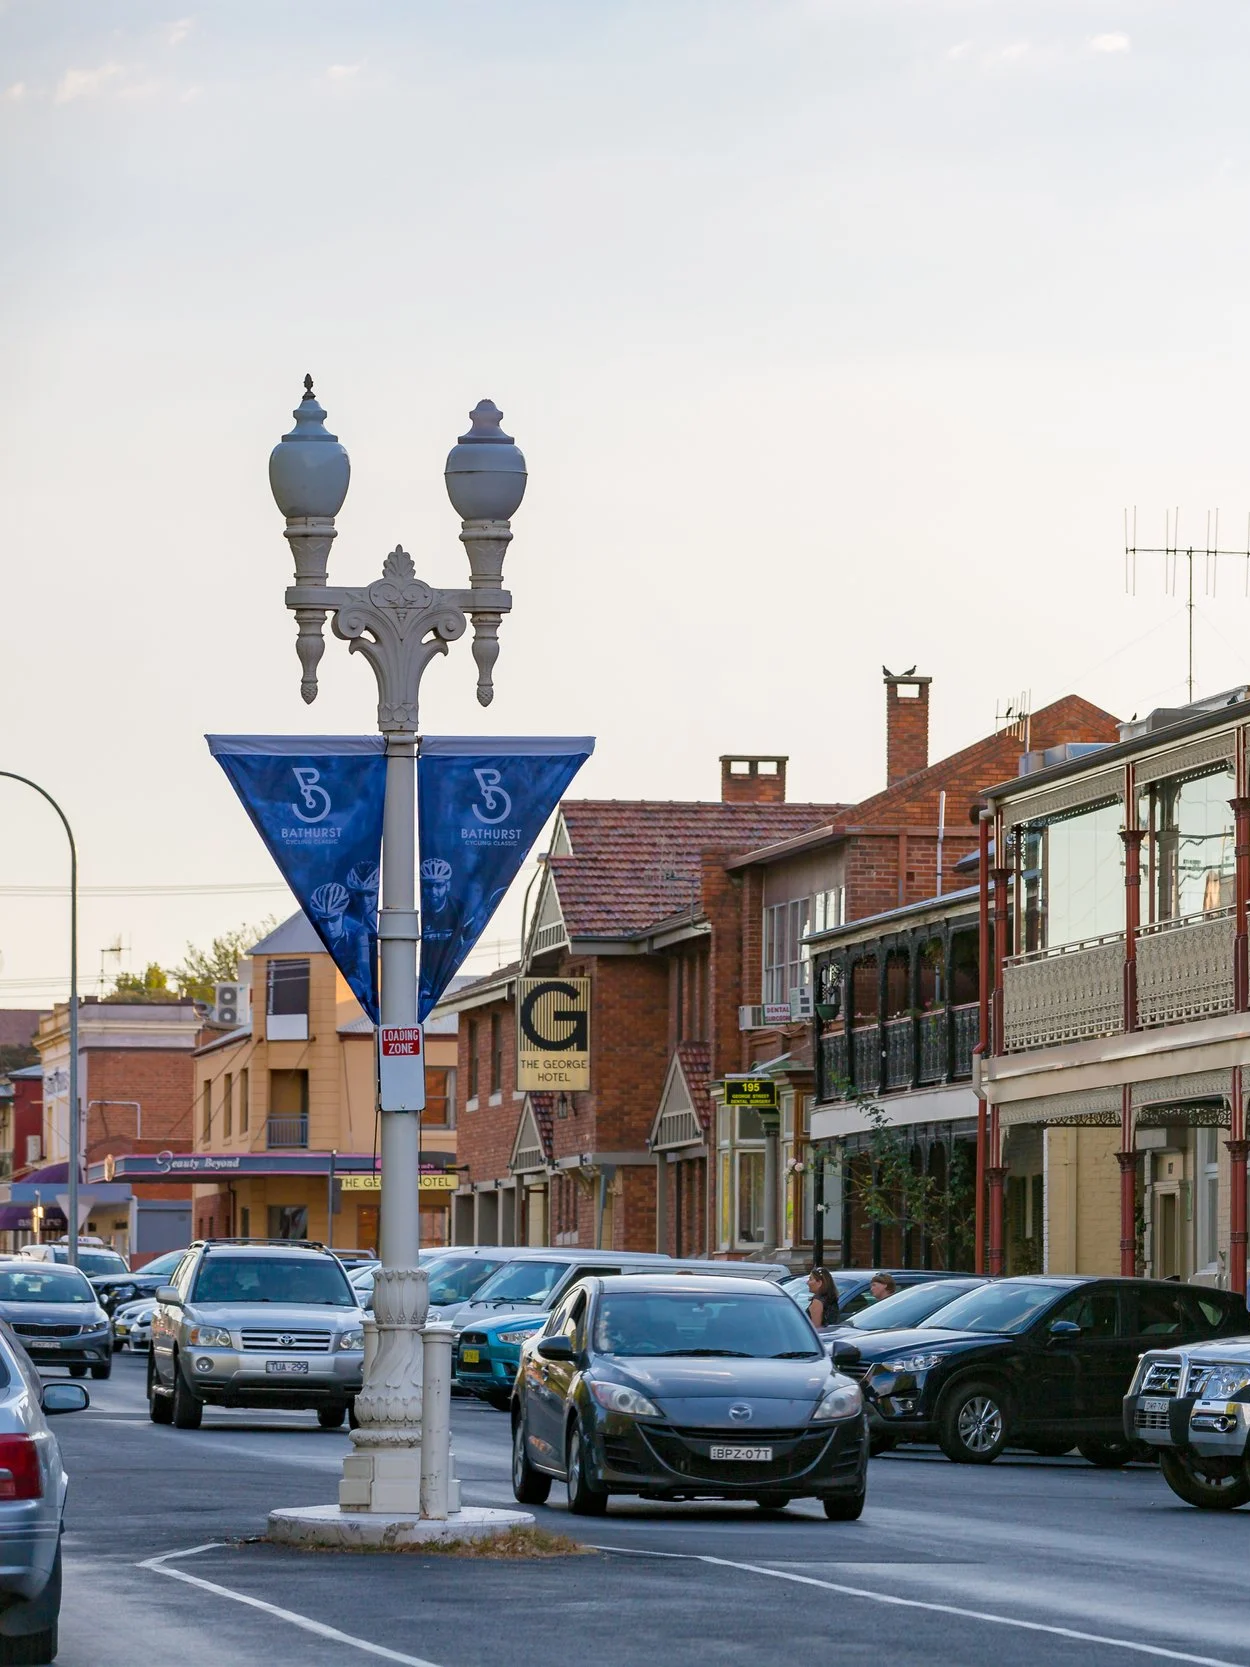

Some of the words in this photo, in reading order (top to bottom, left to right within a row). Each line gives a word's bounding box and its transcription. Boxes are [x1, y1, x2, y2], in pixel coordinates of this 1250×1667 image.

[281, 827, 342, 838] BATHURST
[461, 828, 522, 839] BATHURST
[766, 1006, 790, 1014] DENTAL
[521, 981, 588, 1052] G
[383, 1030, 419, 1042] LOADING
[388, 1043, 414, 1054] ZONE
[521, 1060, 540, 1069] THE
[543, 1060, 587, 1069] GEORGE
[537, 1072, 571, 1082] HOTEL
[742, 1083, 760, 1092] 195
[204, 1157, 240, 1170] Beyond
